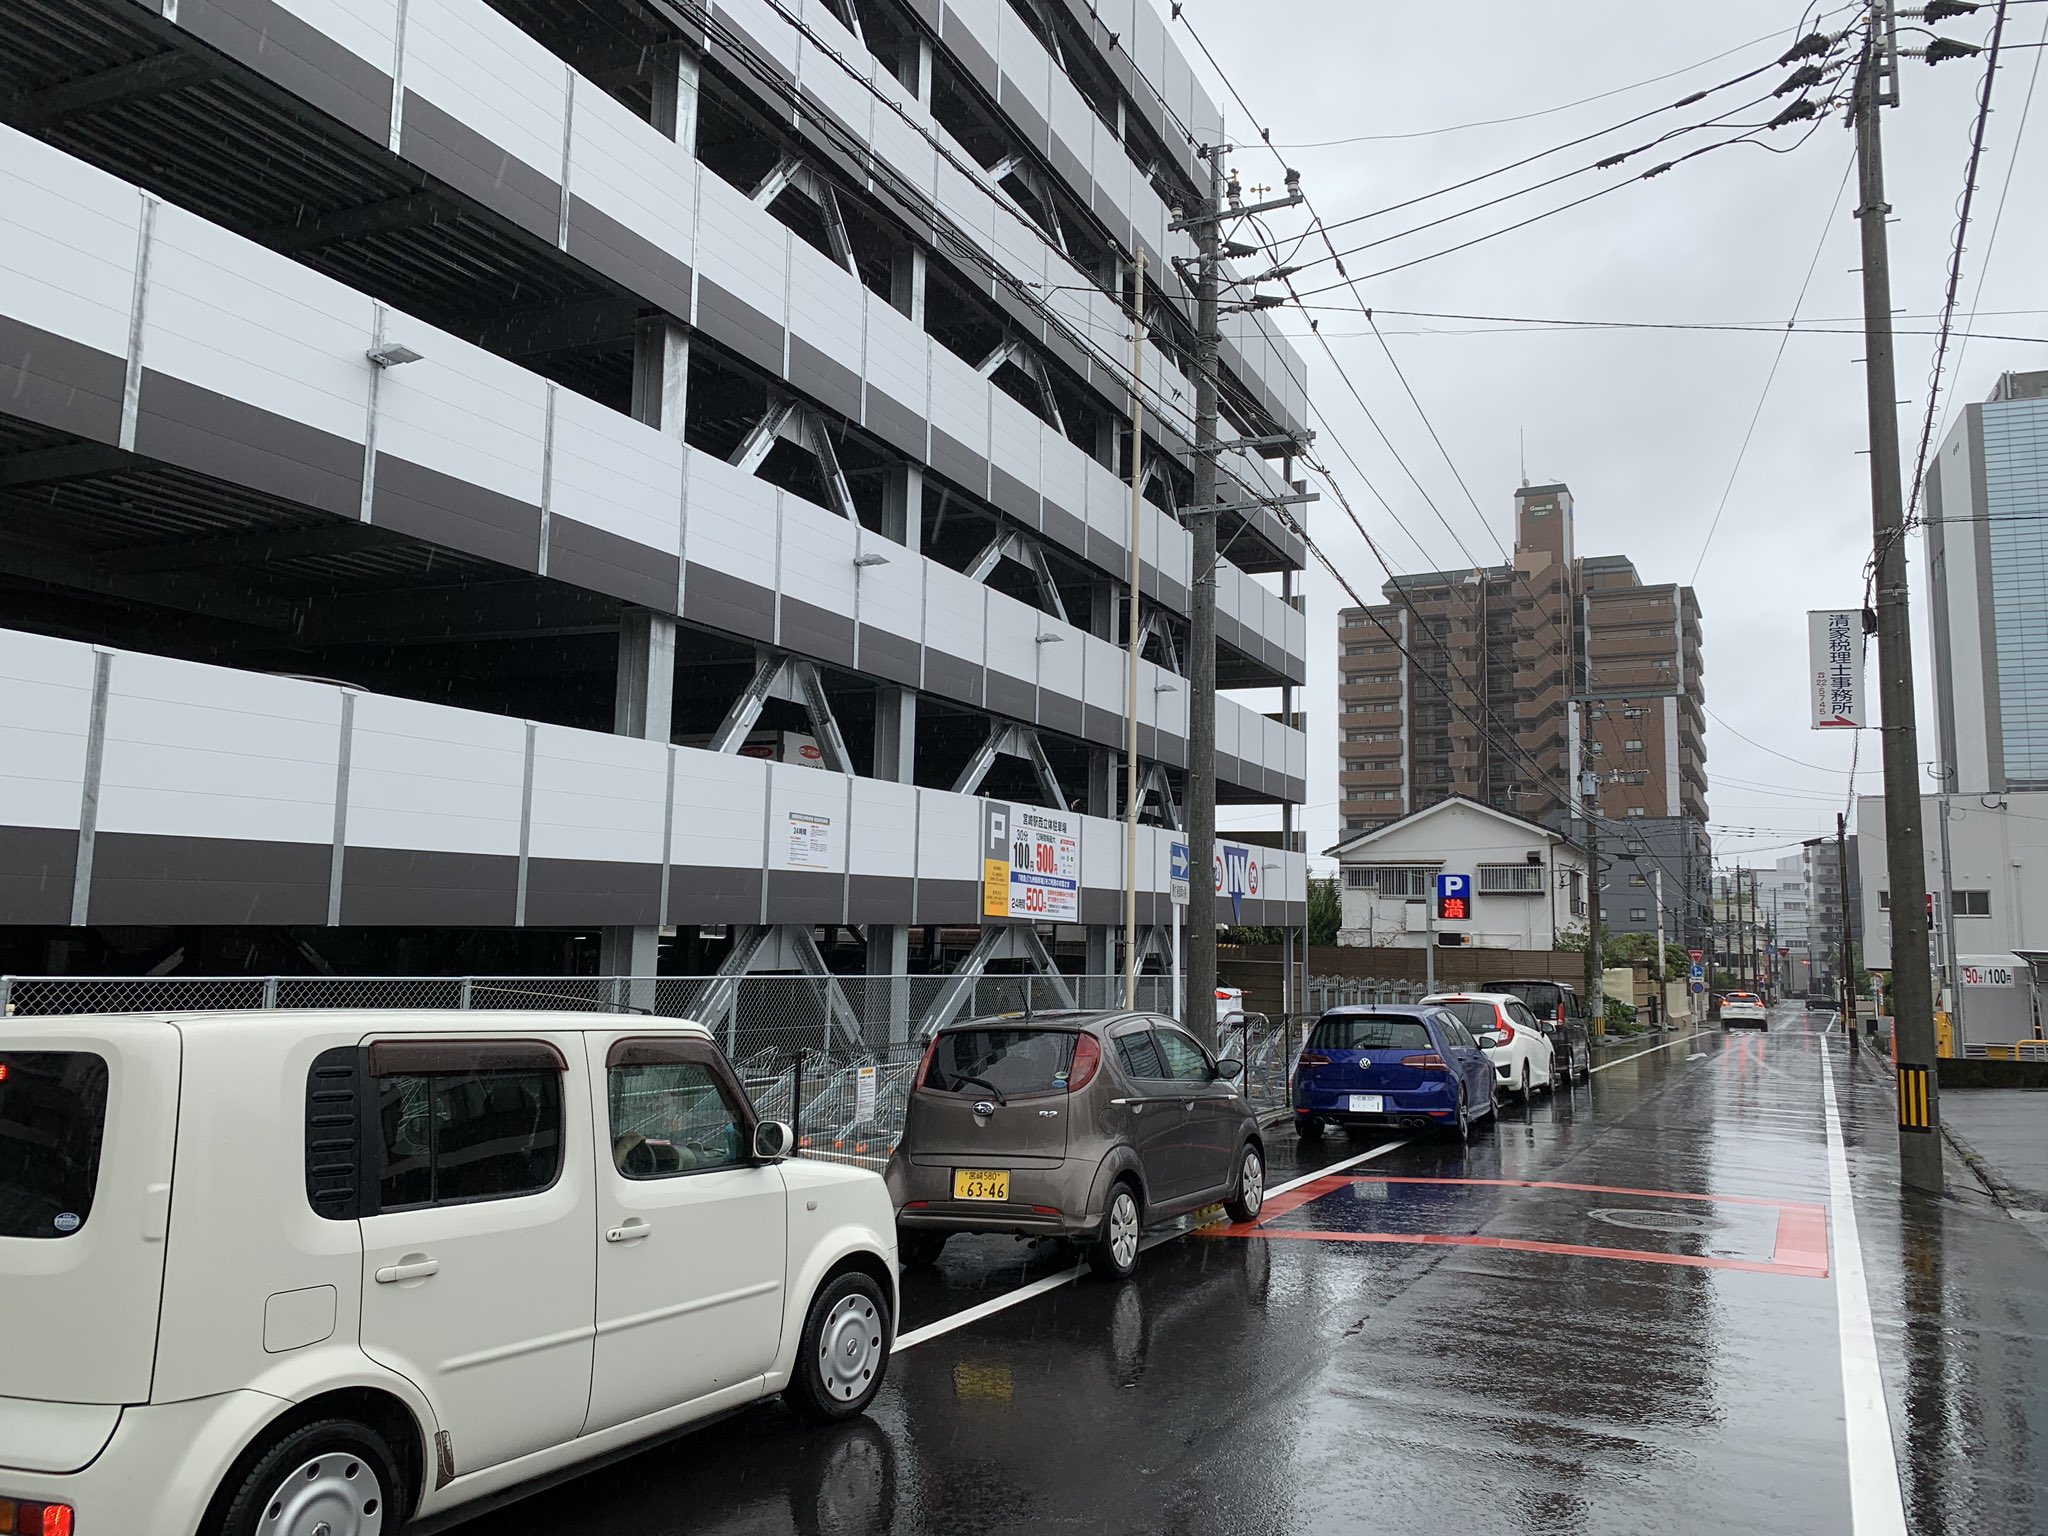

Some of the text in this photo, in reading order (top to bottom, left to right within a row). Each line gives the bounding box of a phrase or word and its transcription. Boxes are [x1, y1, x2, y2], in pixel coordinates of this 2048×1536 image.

[1828, 614, 1853, 714] 清家税理士事務所
[793, 827, 807, 835] 24時間
[991, 812, 1006, 849] P
[1023, 813, 1067, 834] 宮崎駅西立体駐車場
[1016, 829, 1028, 842] 30分
[1228, 854, 1245, 893] IN
[1445, 876, 1463, 896] P
[1444, 899, 1464, 918] 満
[1039, 1110, 1058, 1118] R2
[967, 1182, 1005, 1198] 63-46
